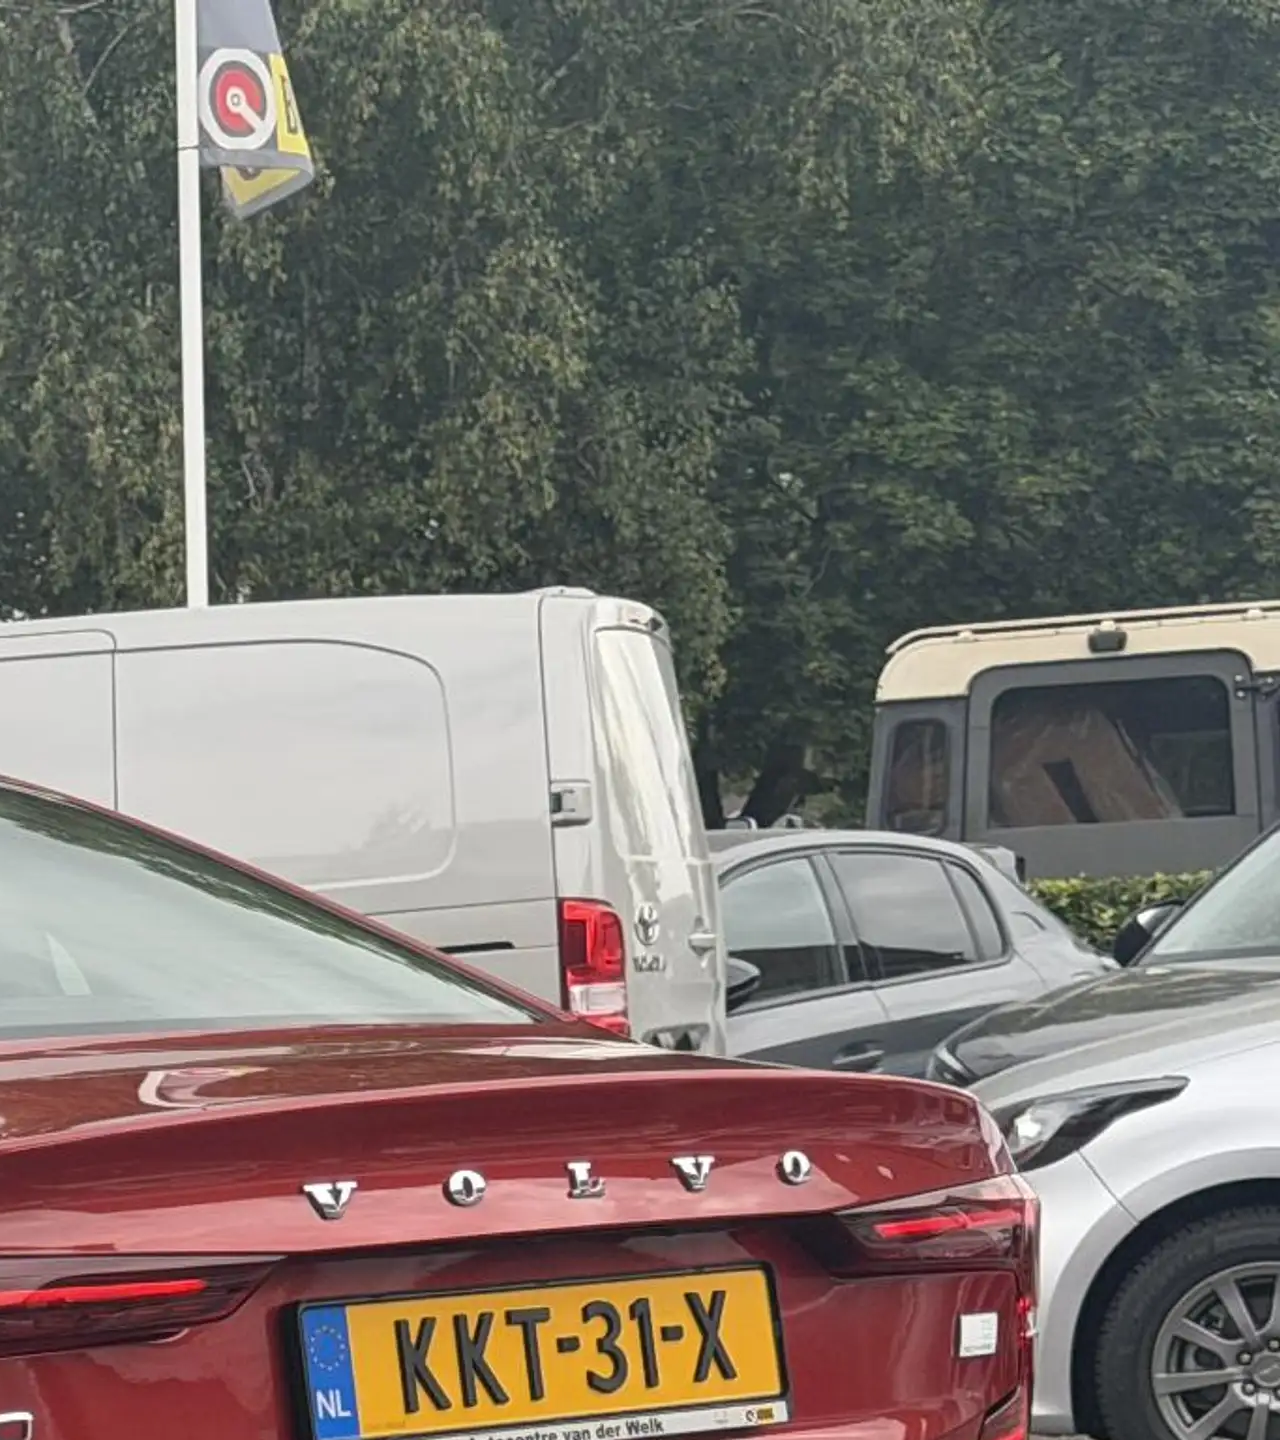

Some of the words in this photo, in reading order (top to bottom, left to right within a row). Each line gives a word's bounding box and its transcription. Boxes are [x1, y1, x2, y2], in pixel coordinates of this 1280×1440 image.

[303, 1150, 811, 1220] VOLVO
[394, 1291, 738, 1413] KKT-31-X
[315, 1389, 352, 1419] NL
[595, 1423, 622, 1439] der
[625, 1417, 664, 1435] Welk
